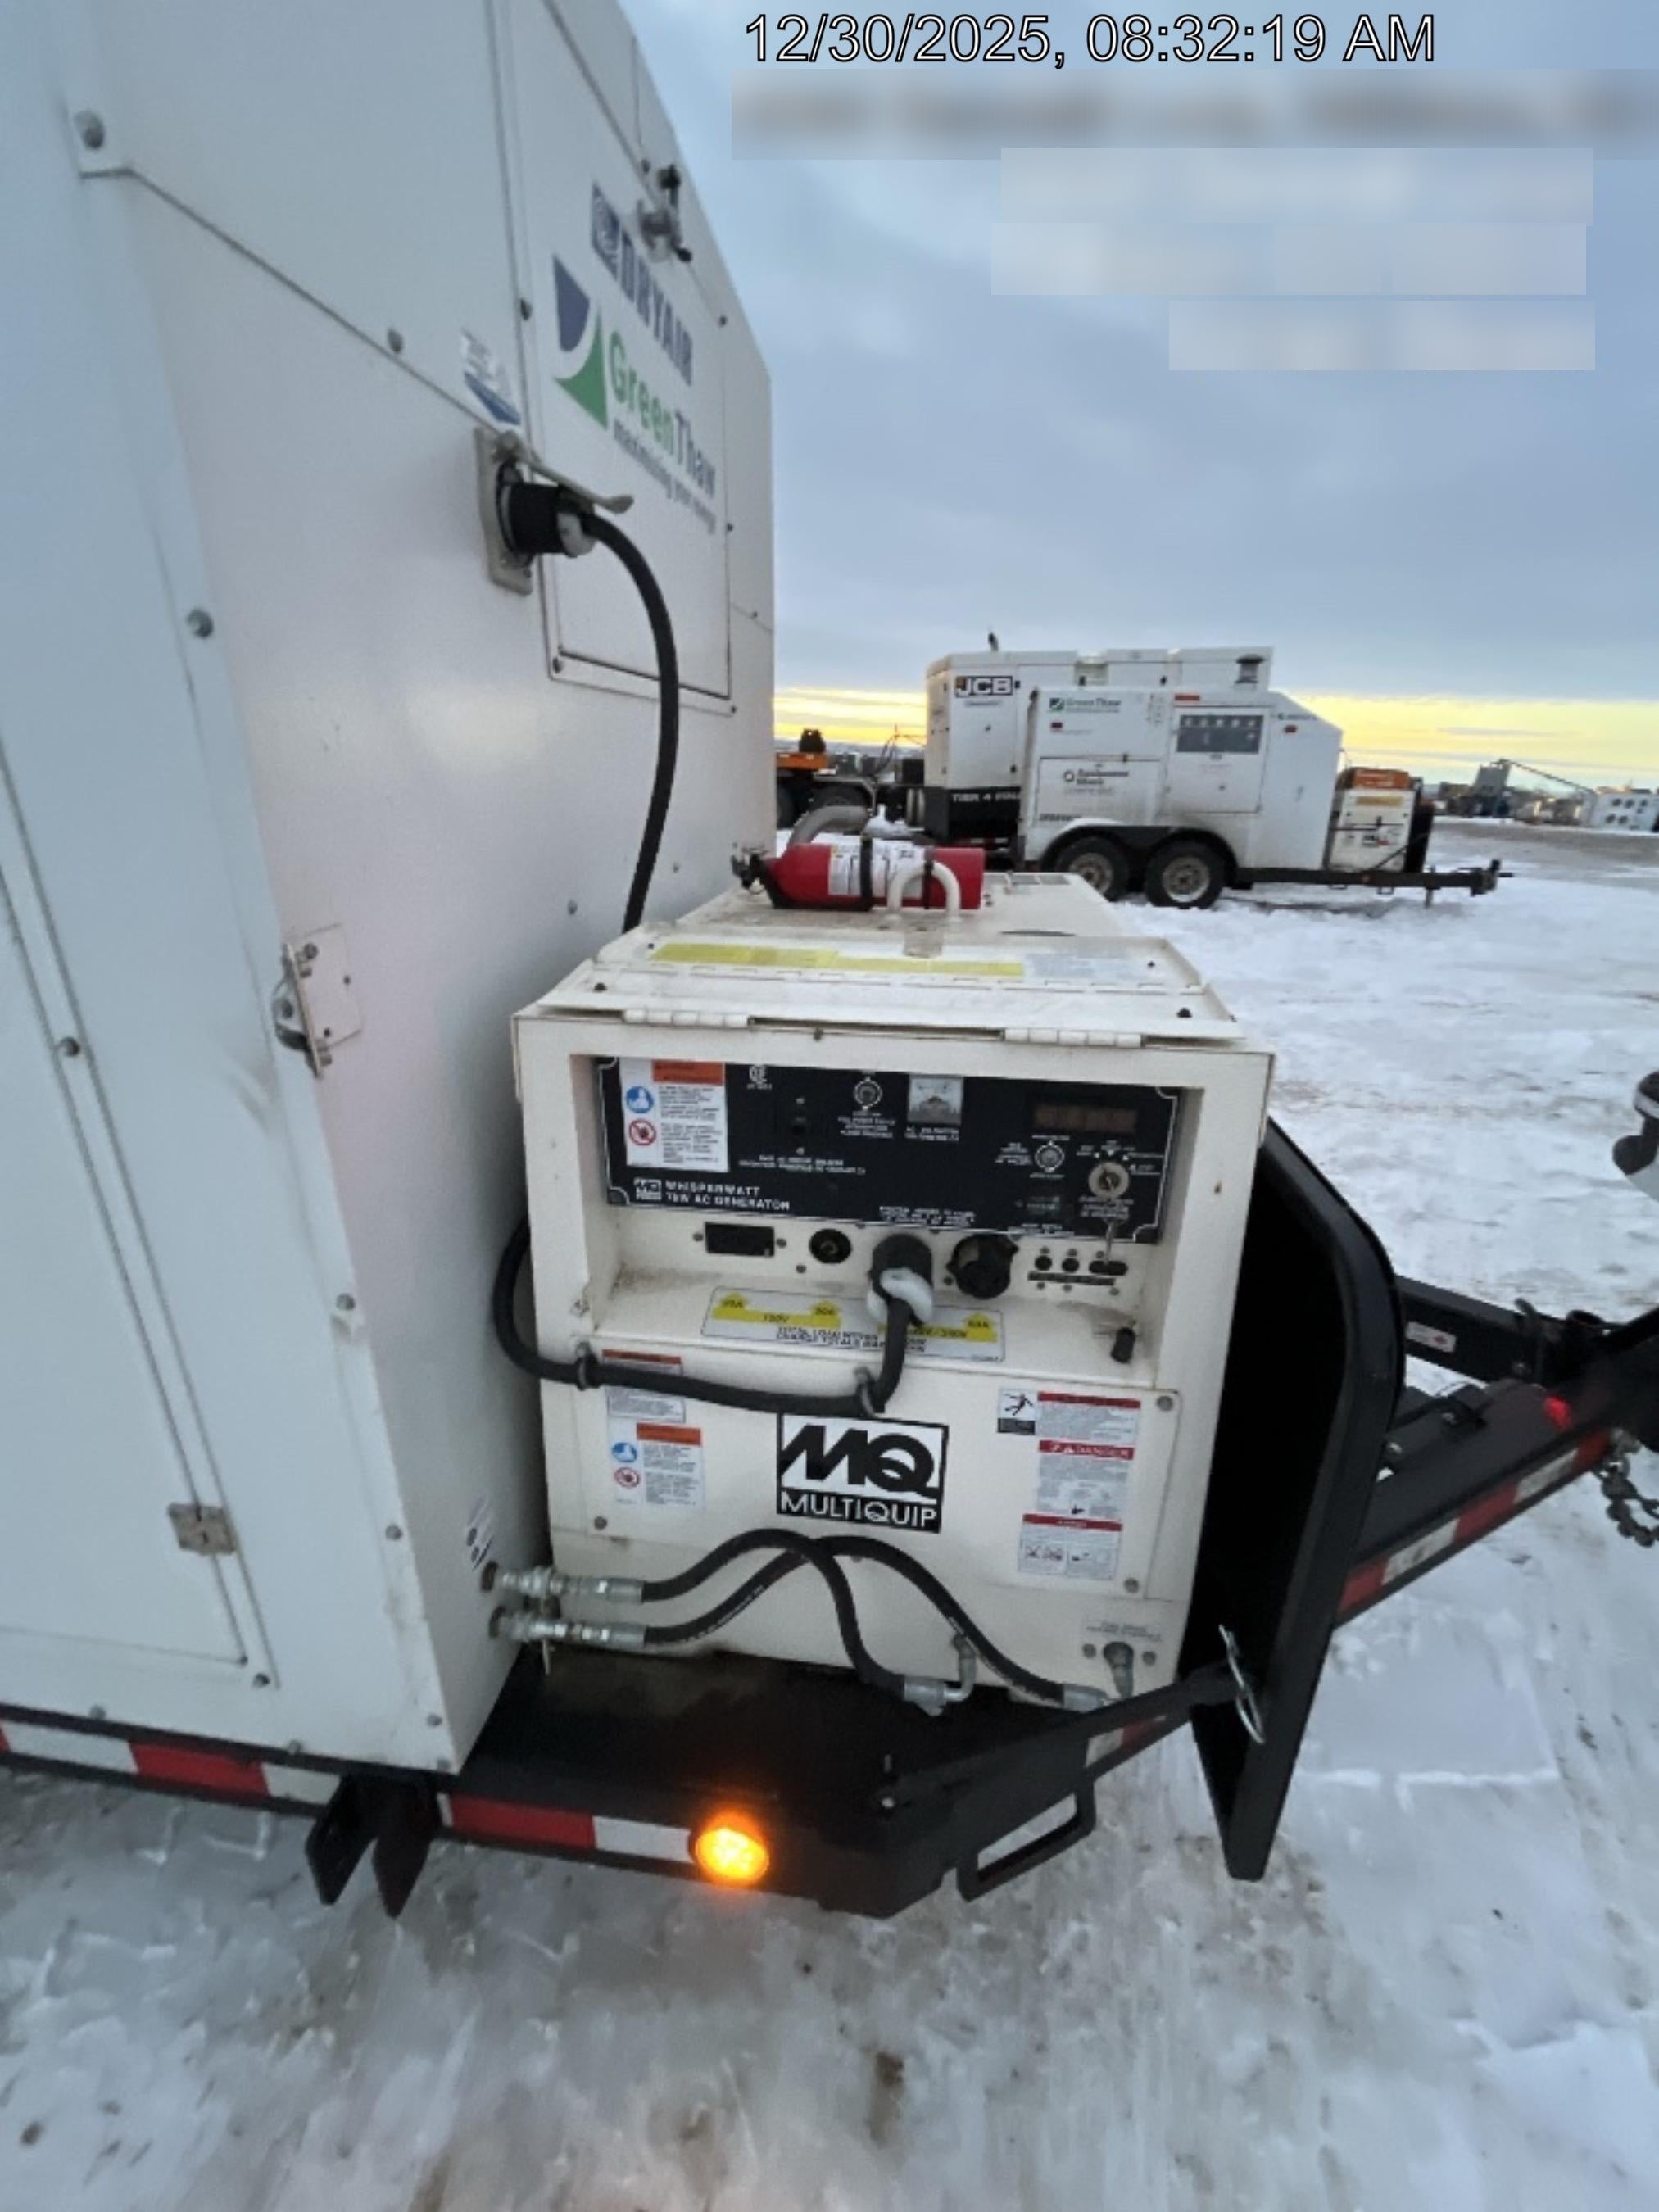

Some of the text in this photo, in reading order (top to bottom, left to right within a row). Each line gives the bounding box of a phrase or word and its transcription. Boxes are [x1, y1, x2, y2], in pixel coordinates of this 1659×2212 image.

[609, 329, 716, 498] GreenThaw
[956, 676, 1013, 696] JCB
[780, 1490, 938, 1530] MULTIQUIP
